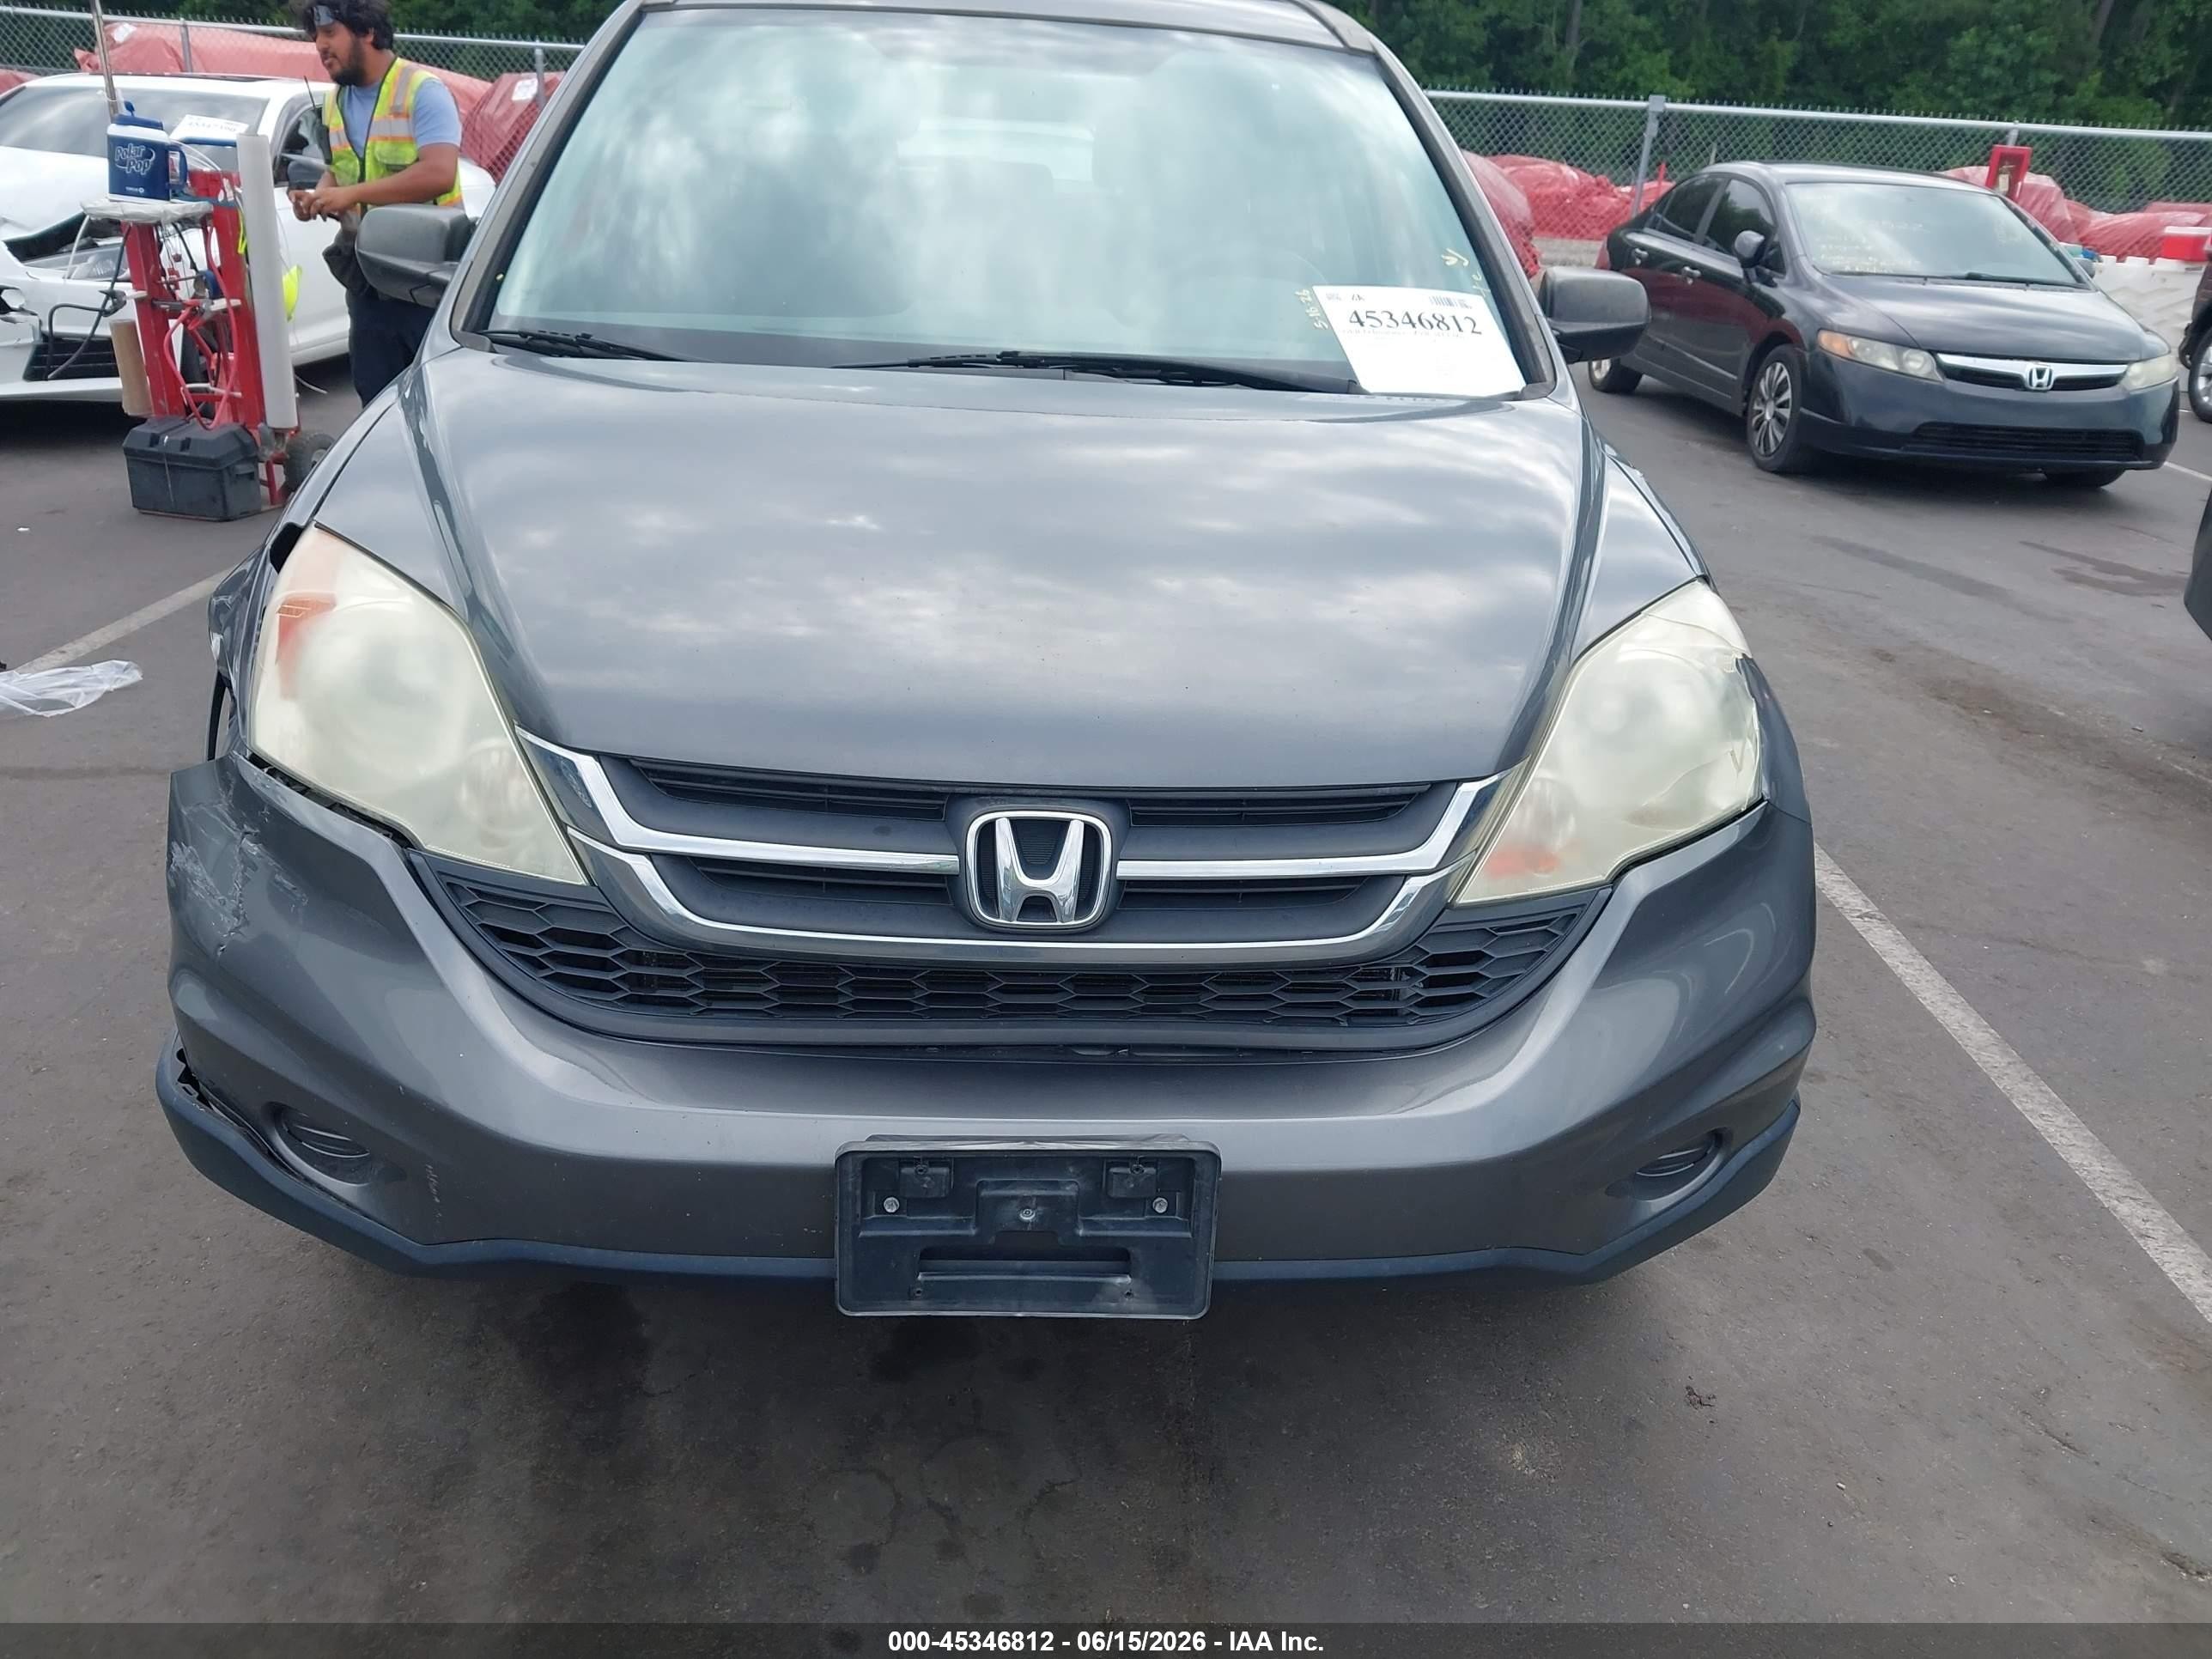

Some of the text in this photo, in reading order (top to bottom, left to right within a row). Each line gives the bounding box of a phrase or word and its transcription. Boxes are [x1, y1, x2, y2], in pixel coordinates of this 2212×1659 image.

[114, 143, 145, 161] Polar
[125, 158, 152, 175] Pop
[1349, 309, 1483, 336] 45346812
